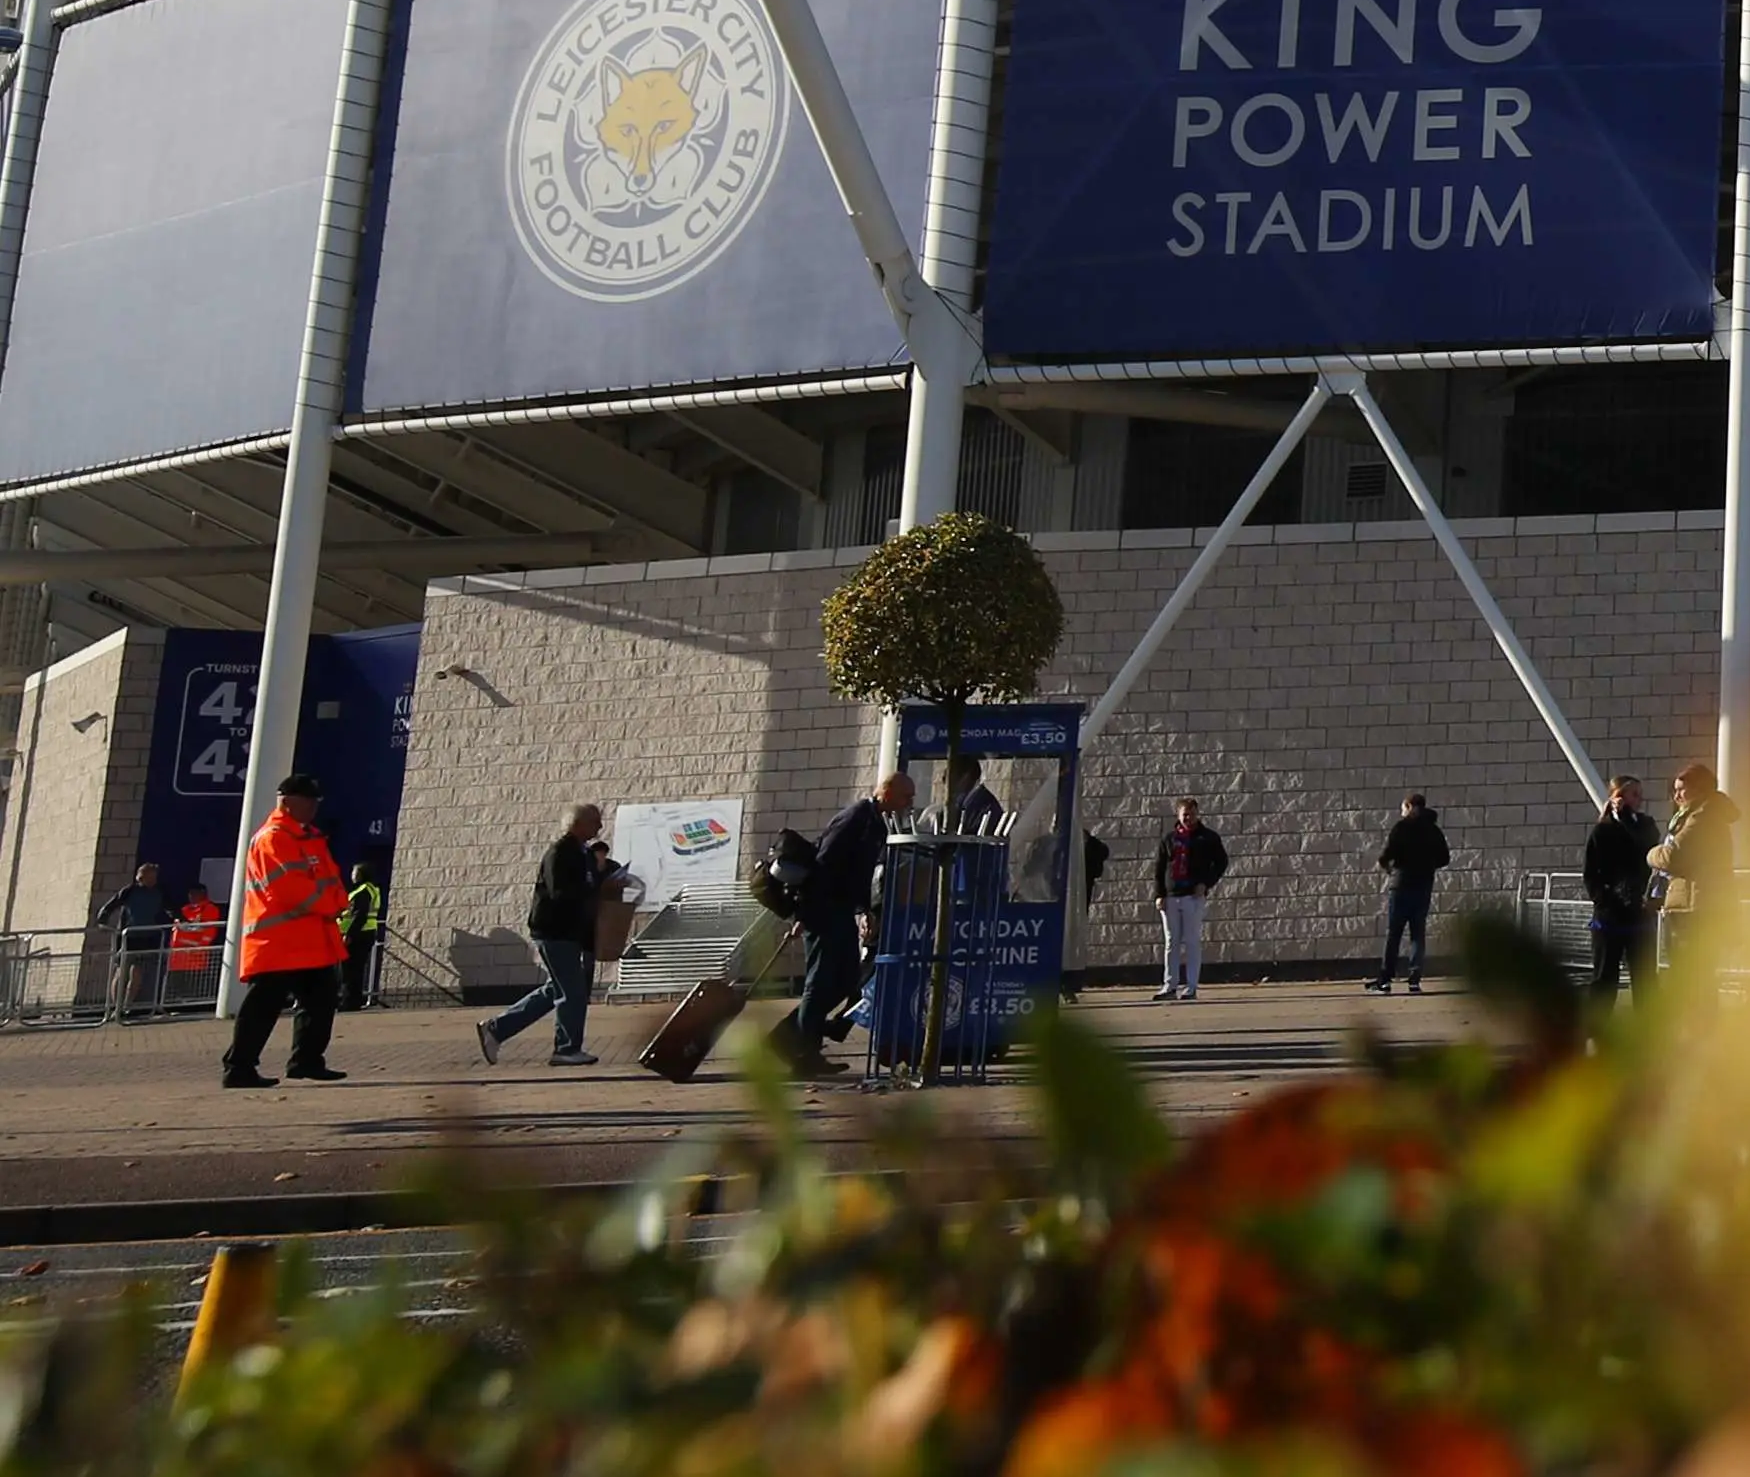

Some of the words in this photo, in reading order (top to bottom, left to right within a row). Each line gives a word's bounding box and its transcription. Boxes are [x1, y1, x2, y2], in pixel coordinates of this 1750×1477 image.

[715, 10, 766, 102] CITY
[1172, 86, 1533, 169] POWER
[529, 150, 682, 272] FOOTBALL
[683, 126, 761, 241] CLUB
[1165, 182, 1535, 258] STADIUM
[205, 663, 258, 675] TURNST
[229, 727, 247, 738] TO
[938, 729, 995, 738] MCHDAY
[1020, 731, 1066, 745] £3.50
[190, 739, 249, 784] 4
[368, 819, 383, 835] 43
[908, 918, 1045, 941] MCHDAY
